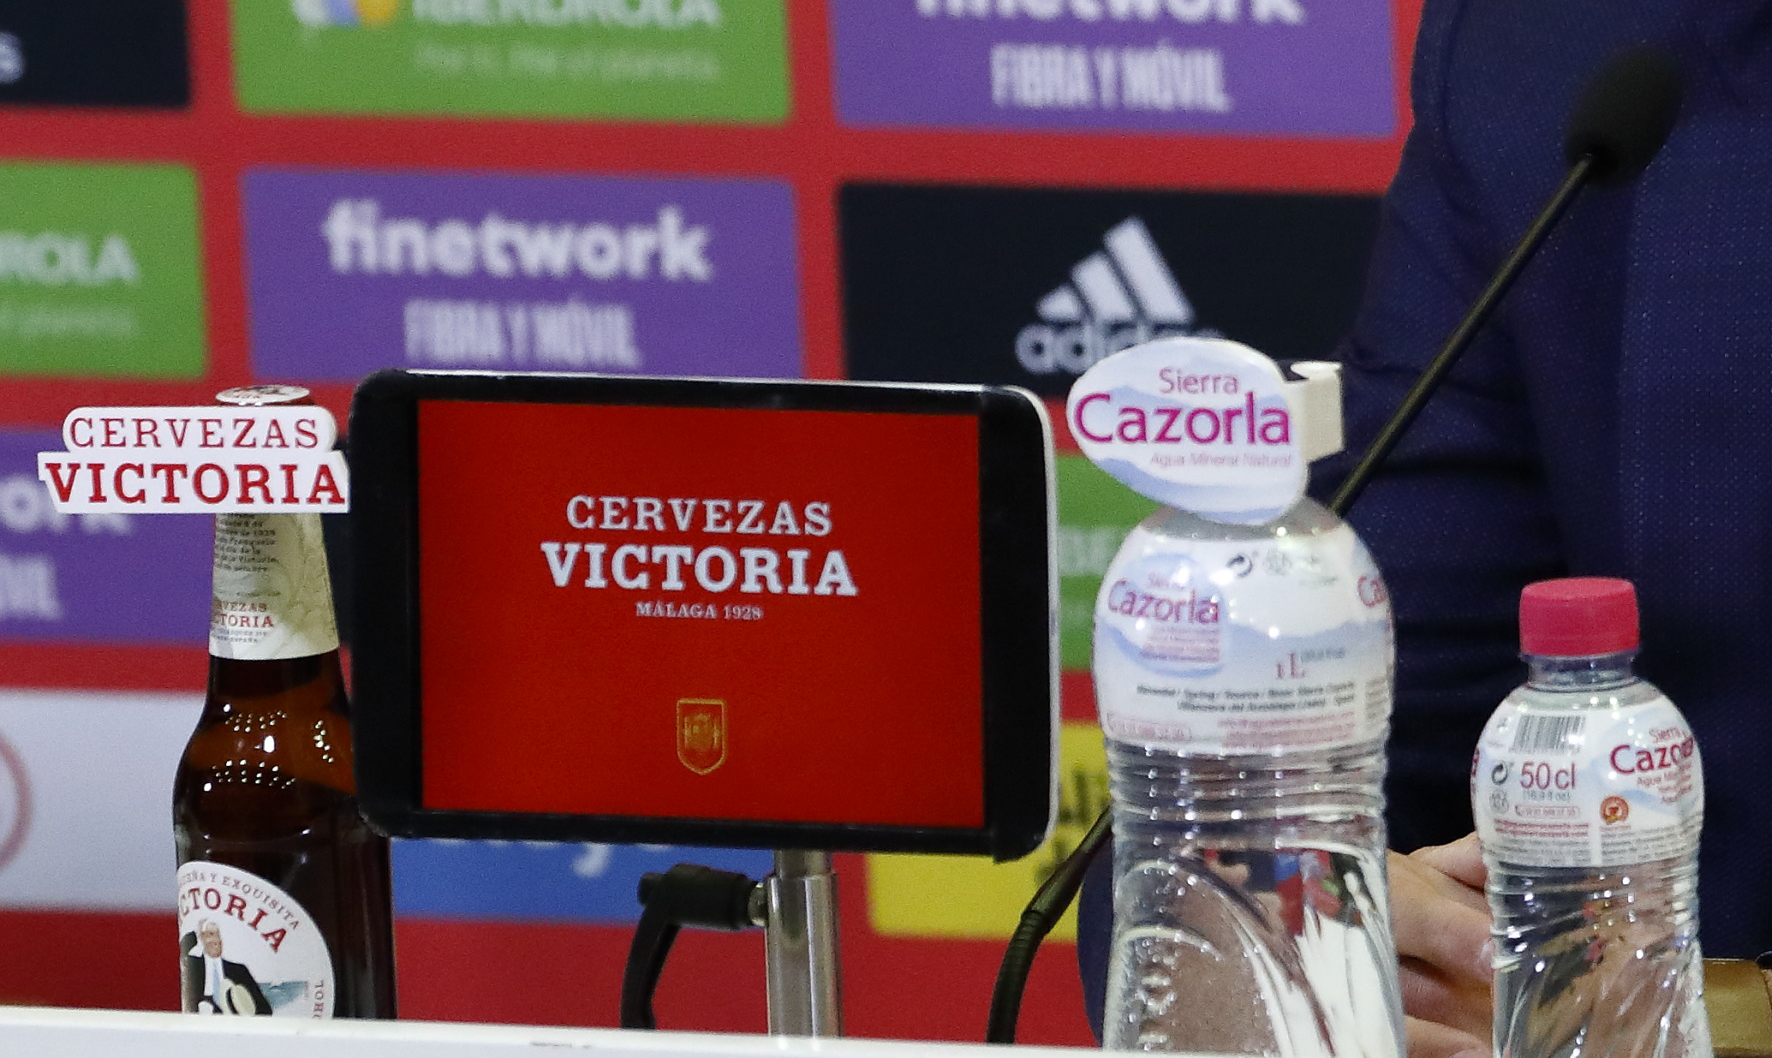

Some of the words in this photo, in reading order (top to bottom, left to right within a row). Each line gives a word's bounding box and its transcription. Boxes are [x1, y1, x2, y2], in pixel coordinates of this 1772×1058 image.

[991, 43, 1092, 108] FIBRA
[1094, 45, 1118, 109] Y
[1123, 38, 1230, 113] MÓVIL
[322, 199, 711, 281] finetwork
[1158, 366, 1240, 394] Sierra
[69, 417, 319, 449] CERVEZAS
[1075, 392, 1291, 445] Cazorla
[1151, 453, 1185, 468] Agua
[45, 462, 346, 505] VICTORIA
[566, 494, 833, 537] CERVEZAS
[541, 541, 859, 597] VICTORIA
[724, 604, 764, 621] 1928
[1108, 578, 1220, 624] Cazorla
[1610, 738, 1694, 774] Cazo
[178, 888, 287, 953] CTORIA
[221, 876, 300, 930] EXQUISITA
